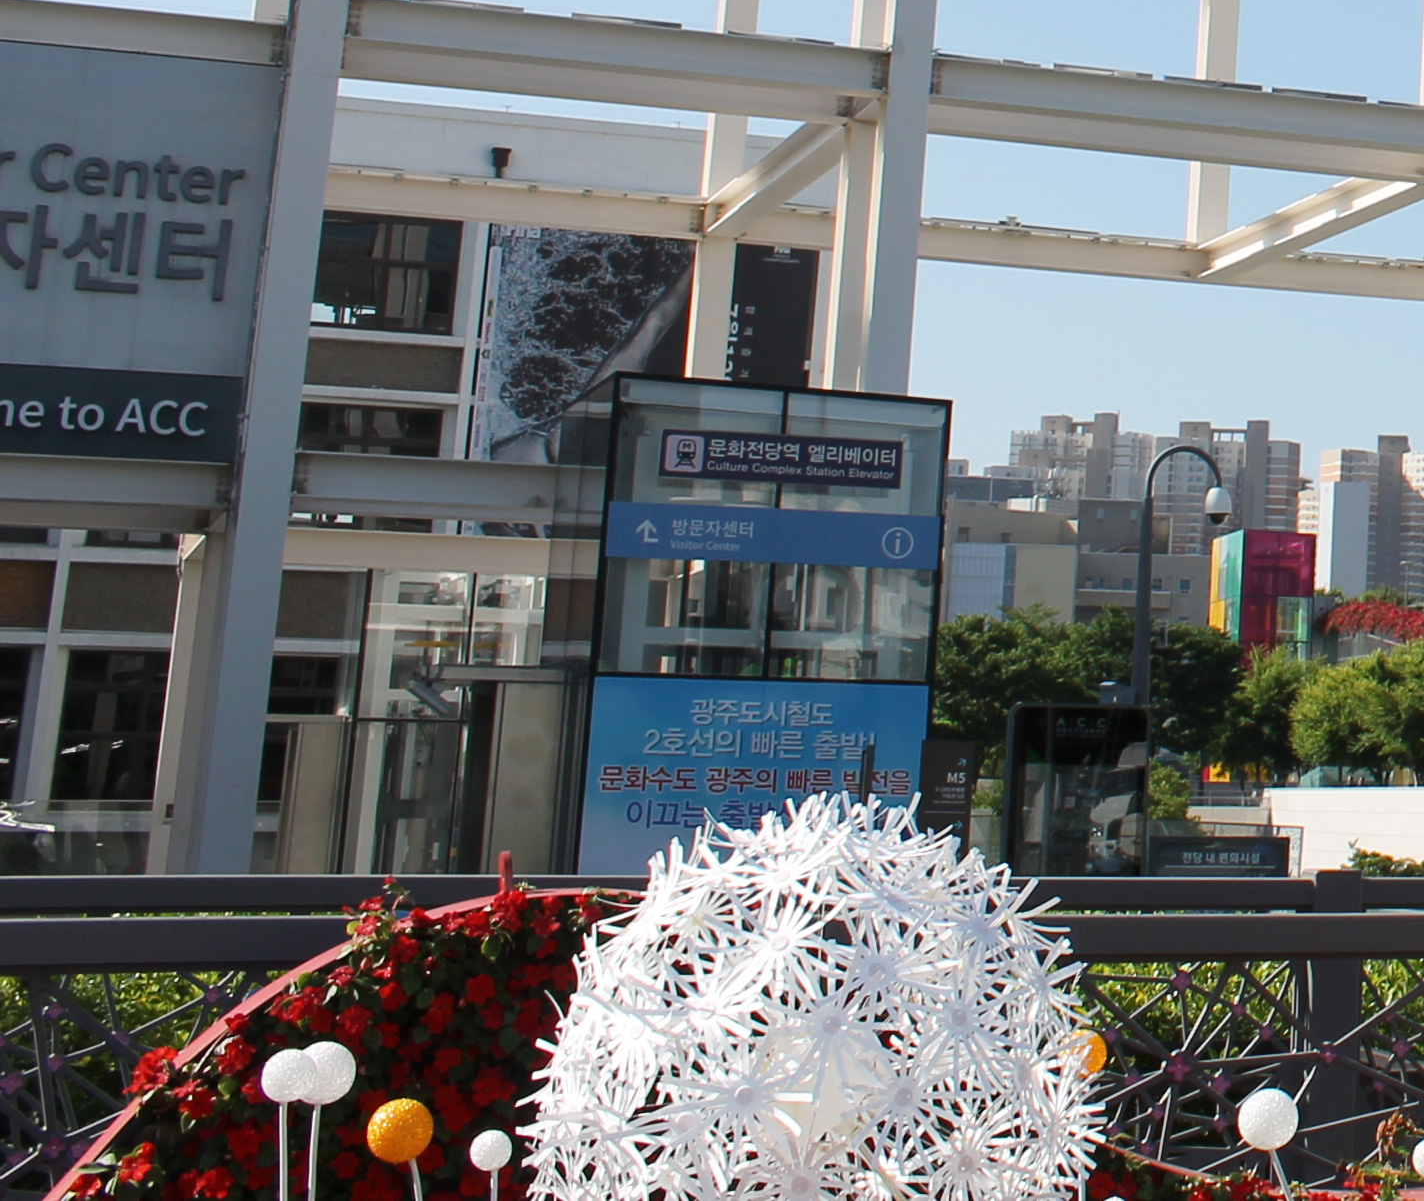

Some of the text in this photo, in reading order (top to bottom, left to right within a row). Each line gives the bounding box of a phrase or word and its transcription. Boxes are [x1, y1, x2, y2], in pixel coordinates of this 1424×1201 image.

[31, 143, 246, 205] Center
[59, 397, 104, 432] to
[115, 398, 208, 437] ACC
[708, 438, 897, 467] 문화전당역 엘리베이터
[706, 461, 895, 480] Culture Complex Station Elevator
[672, 519, 754, 539] 방문자센터
[670, 539, 741, 552] Visitor Center
[690, 699, 835, 727] 광주도시철도
[642, 728, 742, 758] 2호선의
[751, 730, 804, 760] 빠른
[599, 765, 698, 792] 문화수도
[706, 768, 778, 794] 광주의
[786, 768, 834, 794] 빠른
[947, 772, 966, 783] M5
[1182, 852, 1261, 864] 전당 내 편의시설
